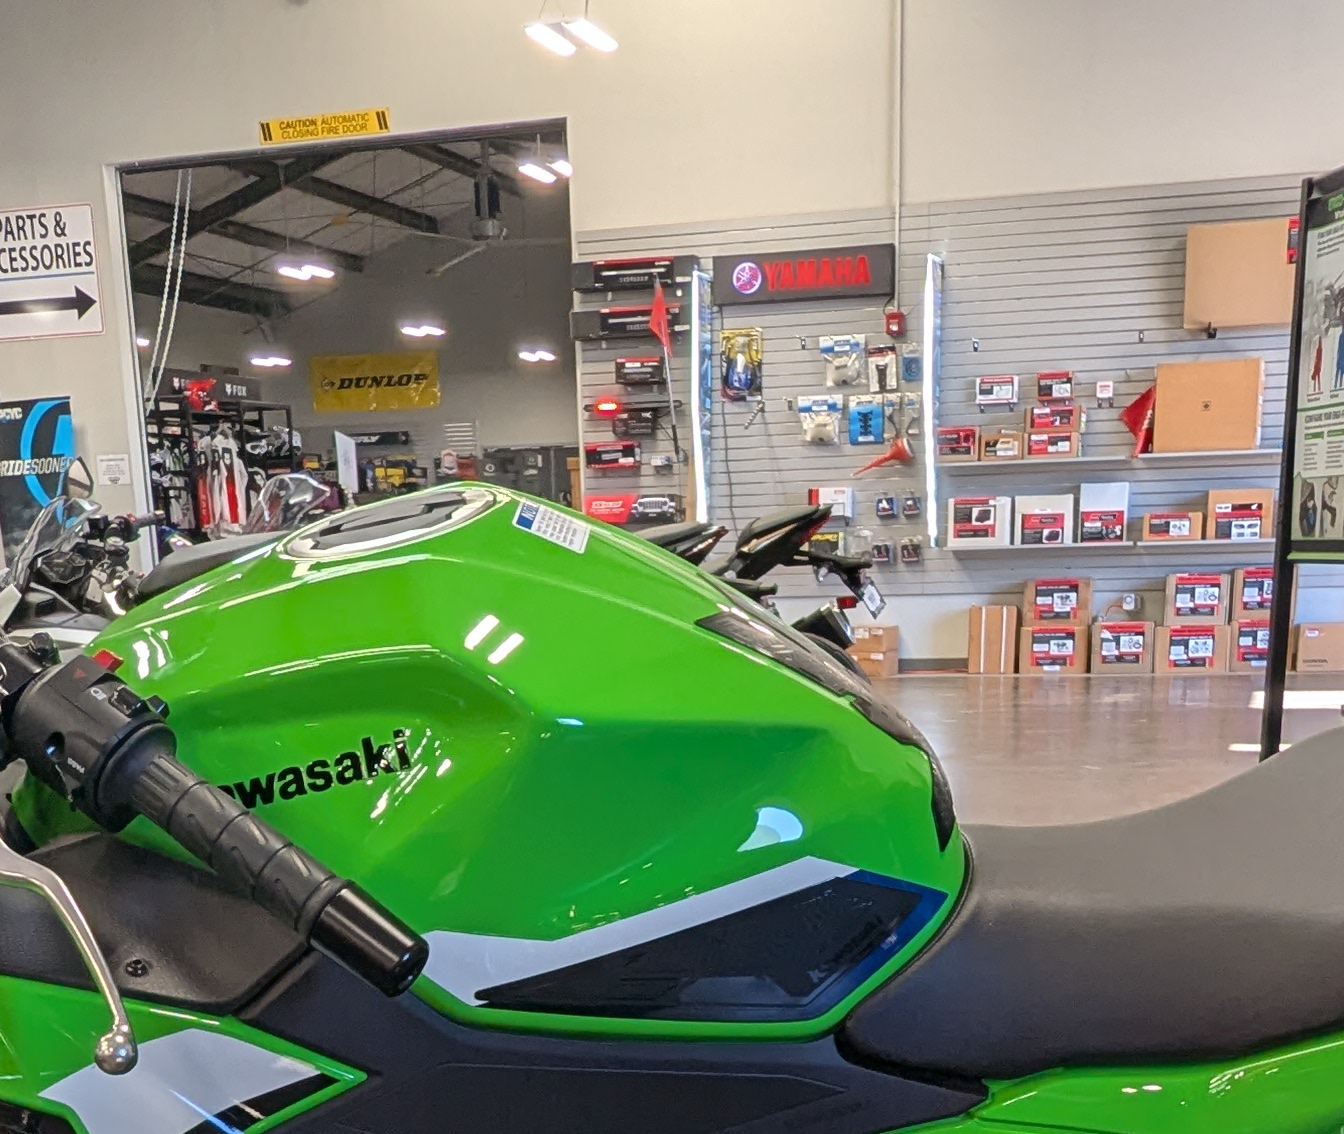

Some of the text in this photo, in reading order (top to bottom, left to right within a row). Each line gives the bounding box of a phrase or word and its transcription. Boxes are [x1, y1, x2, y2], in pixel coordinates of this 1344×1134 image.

[321, 112, 370, 127] AUTOMATIC
[281, 123, 368, 140] CLOSING FIRE DOOR
[53, 211, 67, 238] &
[764, 254, 871, 291] YAMAHA
[337, 373, 429, 390] DUNLOP
[232, 384, 247, 397] FOX
[217, 728, 411, 809] wasaki
